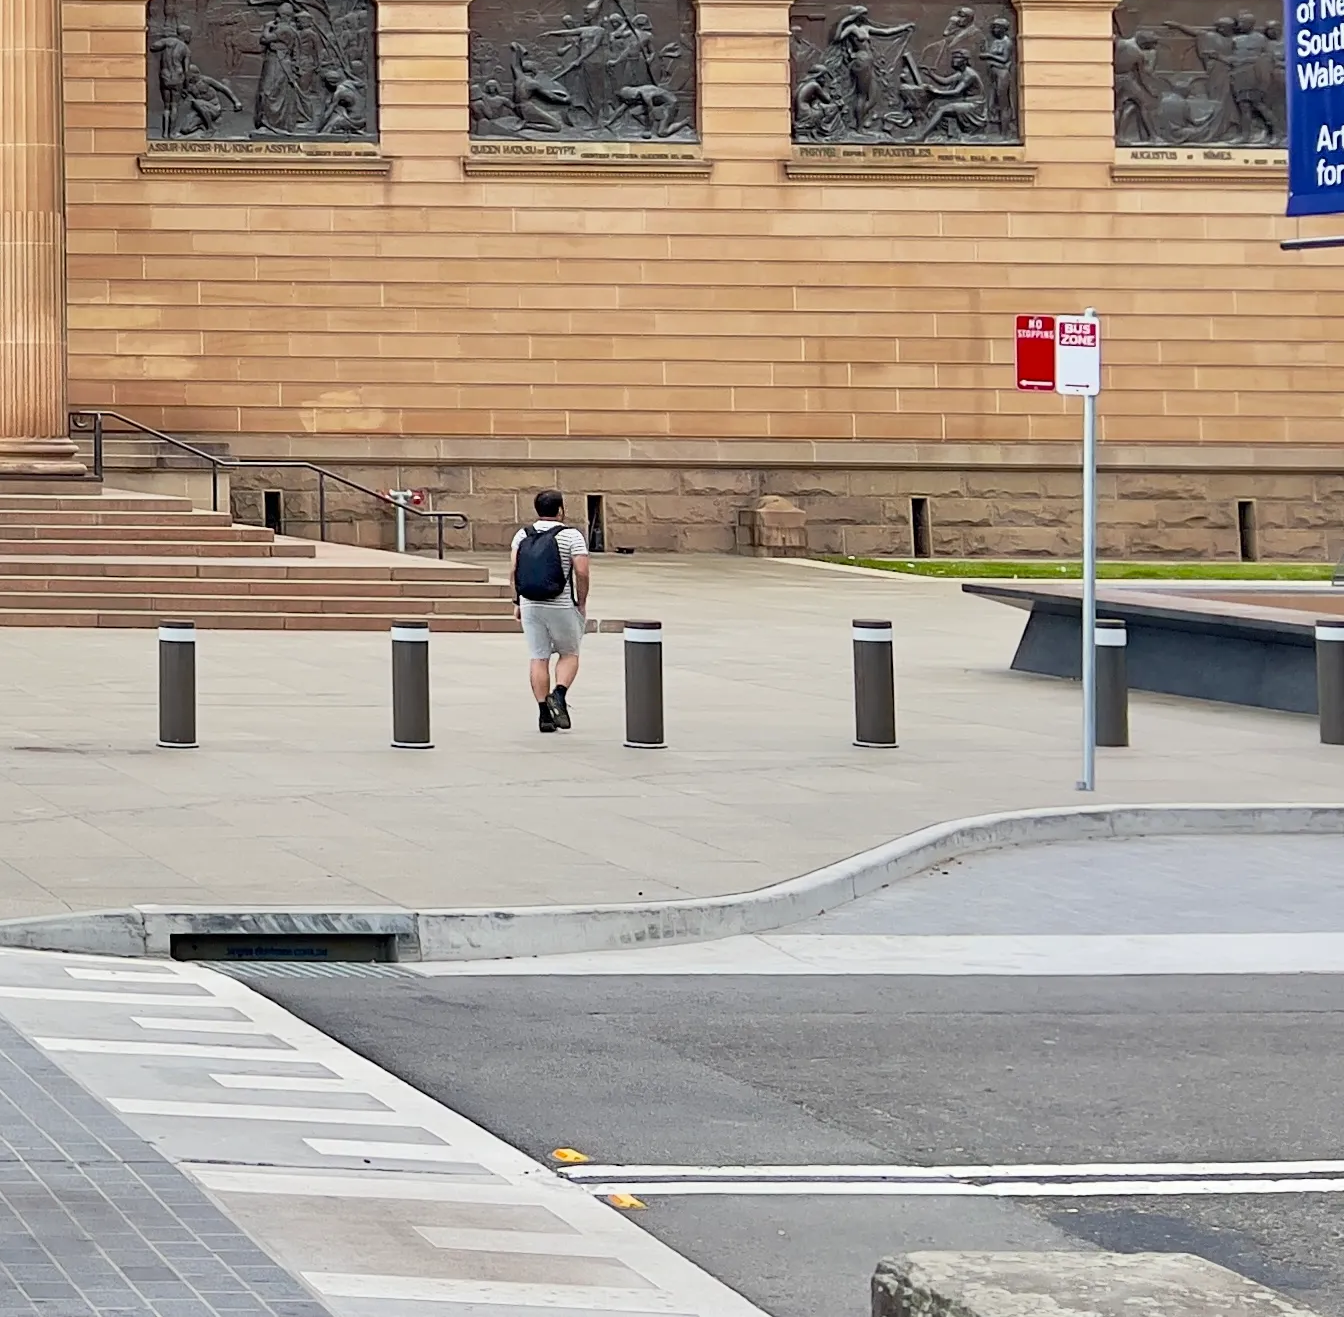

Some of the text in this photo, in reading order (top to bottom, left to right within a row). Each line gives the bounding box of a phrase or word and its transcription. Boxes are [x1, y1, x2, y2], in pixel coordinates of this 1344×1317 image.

[1316, 158, 1344, 187] for
[1028, 319, 1043, 330] NO
[1064, 323, 1091, 335] BUS
[1017, 329, 1054, 340] STOPPING
[1060, 334, 1095, 346] ZONE
